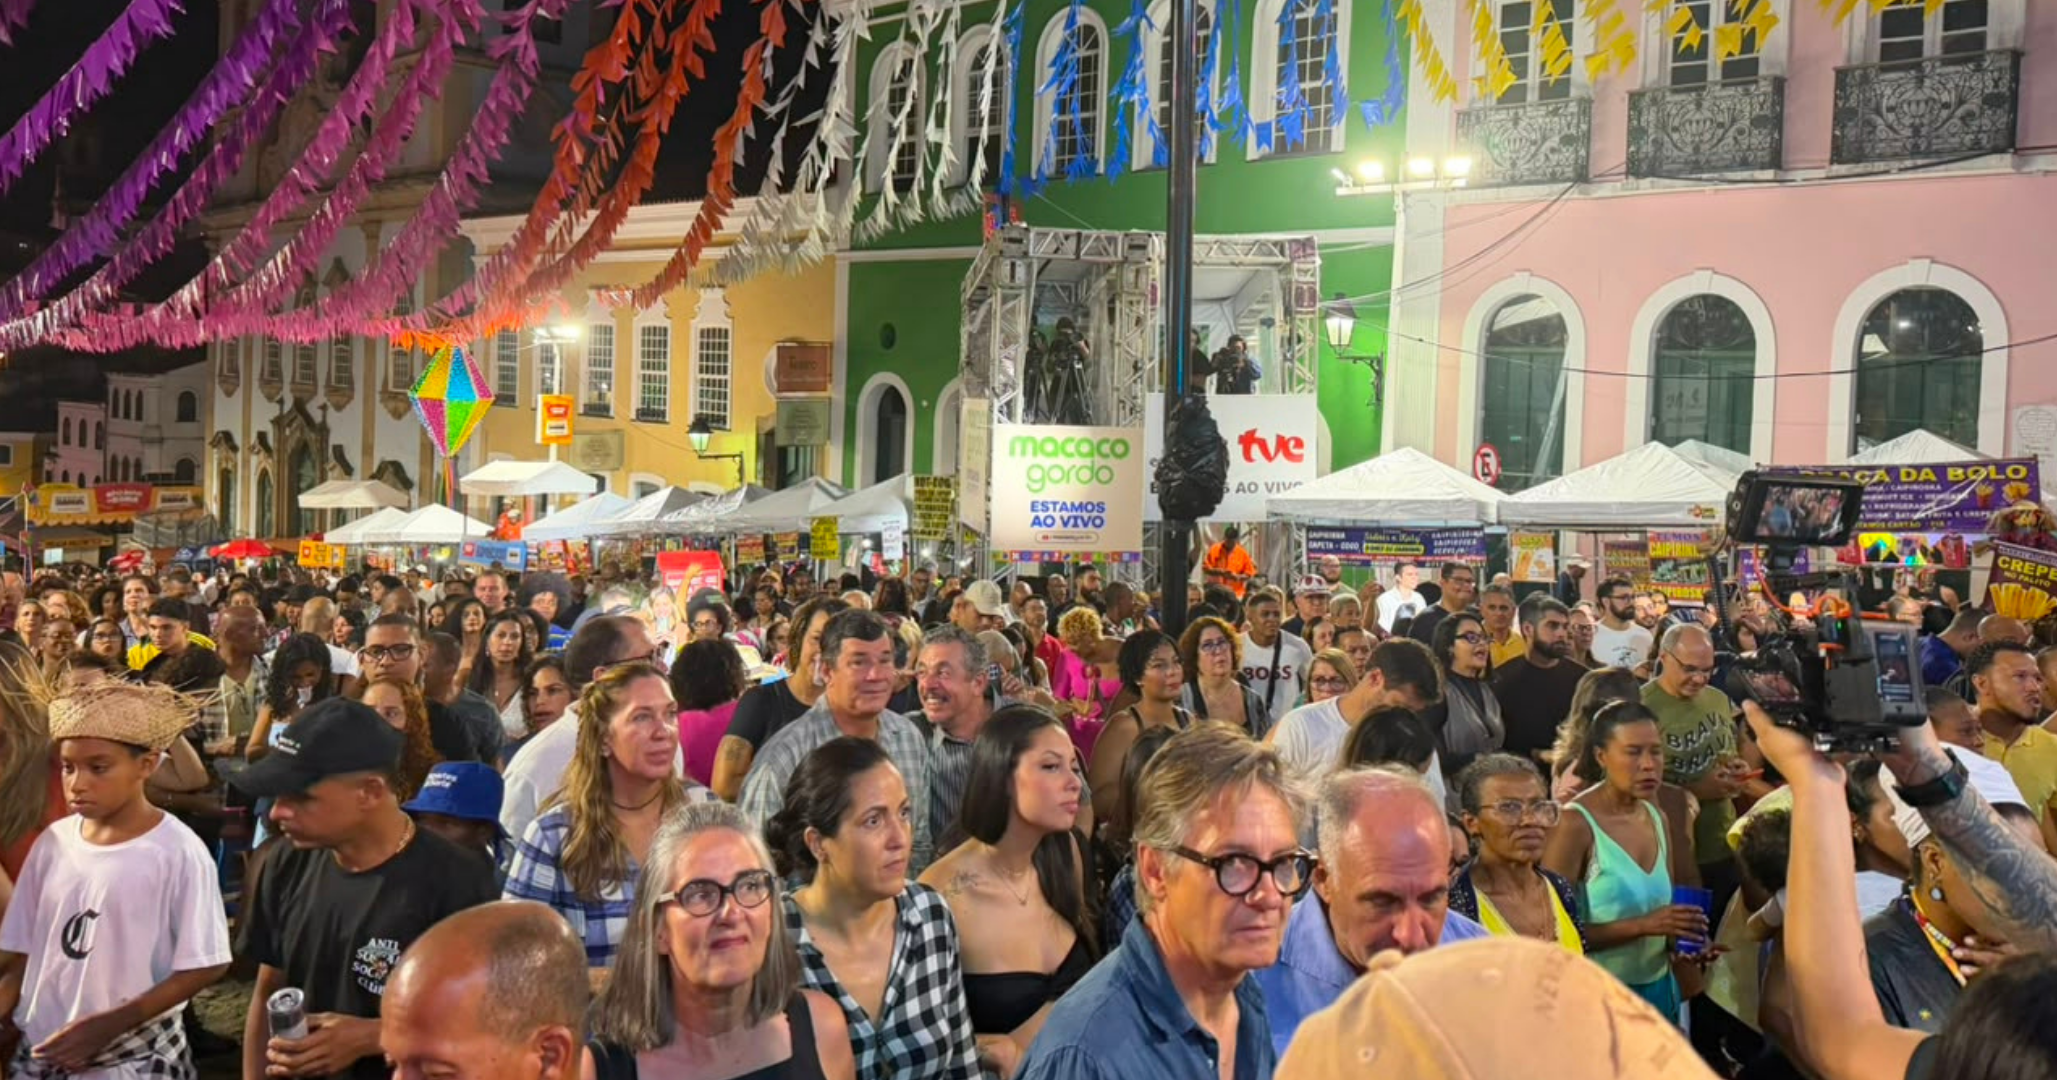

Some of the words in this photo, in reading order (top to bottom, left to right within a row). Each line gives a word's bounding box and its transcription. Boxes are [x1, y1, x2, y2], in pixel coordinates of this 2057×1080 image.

[1009, 436, 1130, 460] macaco
[1238, 428, 1304, 463] tve
[1026, 459, 1114, 493] gordo
[1900, 467, 1937, 483] DA
[1947, 463, 2028, 482] BOLO
[1235, 481, 1259, 494] AO
[1030, 501, 1106, 514] ESTAMOS
[1030, 515, 1056, 528] AO
[1060, 515, 1105, 528] VIVO
[61, 908, 101, 960] C
[368, 938, 399, 950] ANTI
